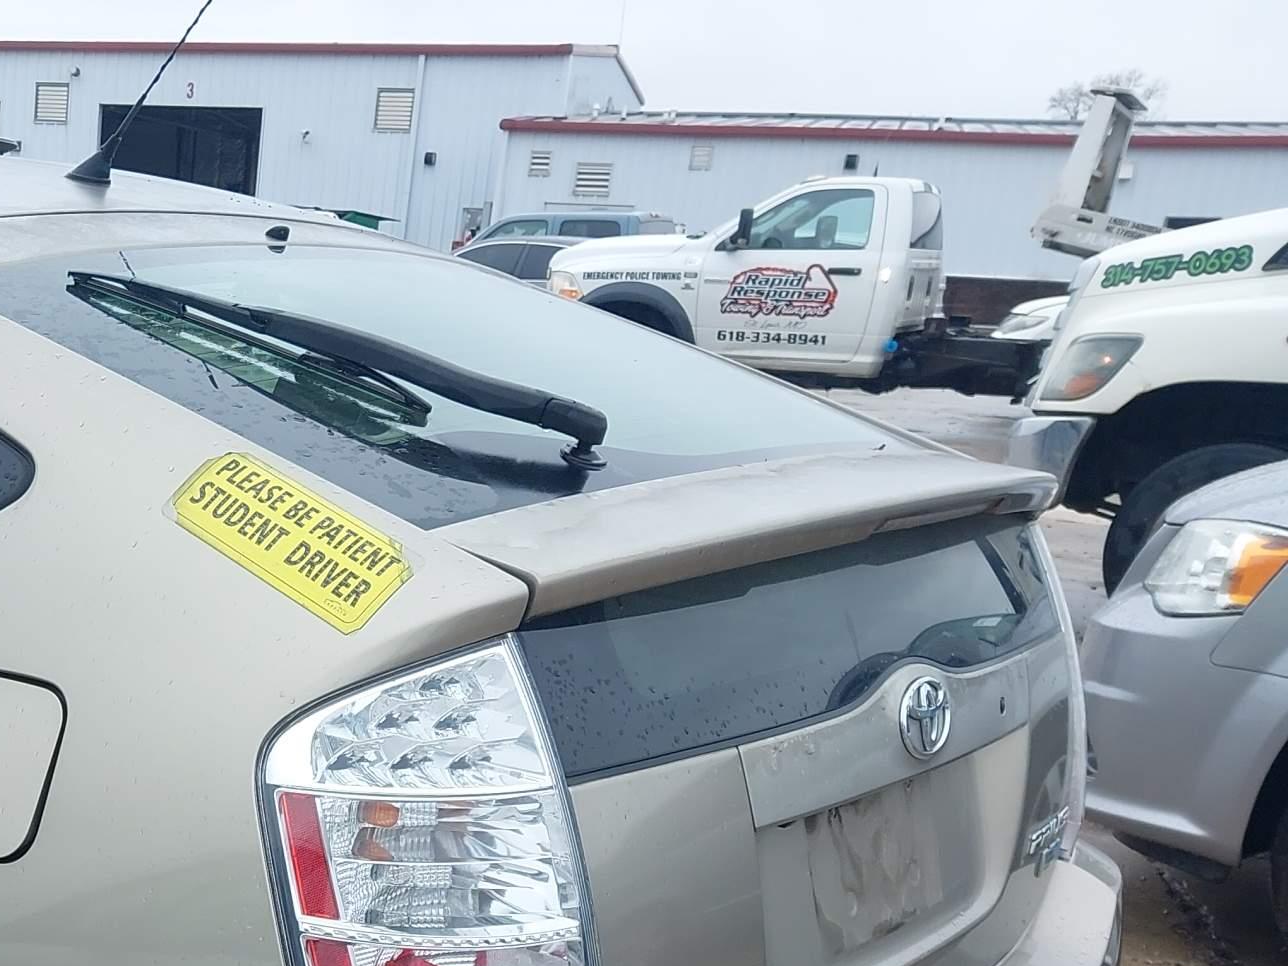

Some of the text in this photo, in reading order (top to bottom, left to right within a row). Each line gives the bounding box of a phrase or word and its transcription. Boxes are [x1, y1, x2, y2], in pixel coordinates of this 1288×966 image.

[186, 81, 194, 99] 3
[1100, 244, 1254, 289] 314-757-0693
[582, 271, 623, 281] EMERGENCY
[625, 271, 650, 281] POLICE
[652, 271, 682, 281] TOWING
[745, 274, 803, 288] Rapid
[730, 286, 827, 301] Response
[720, 299, 760, 319] Towing
[774, 302, 833, 320] Transport
[717, 329, 827, 346] 618-334-8941
[215, 458, 402, 577] PLEASE BE PATIENT
[189, 481, 372, 608] STUDENT DRIVER
